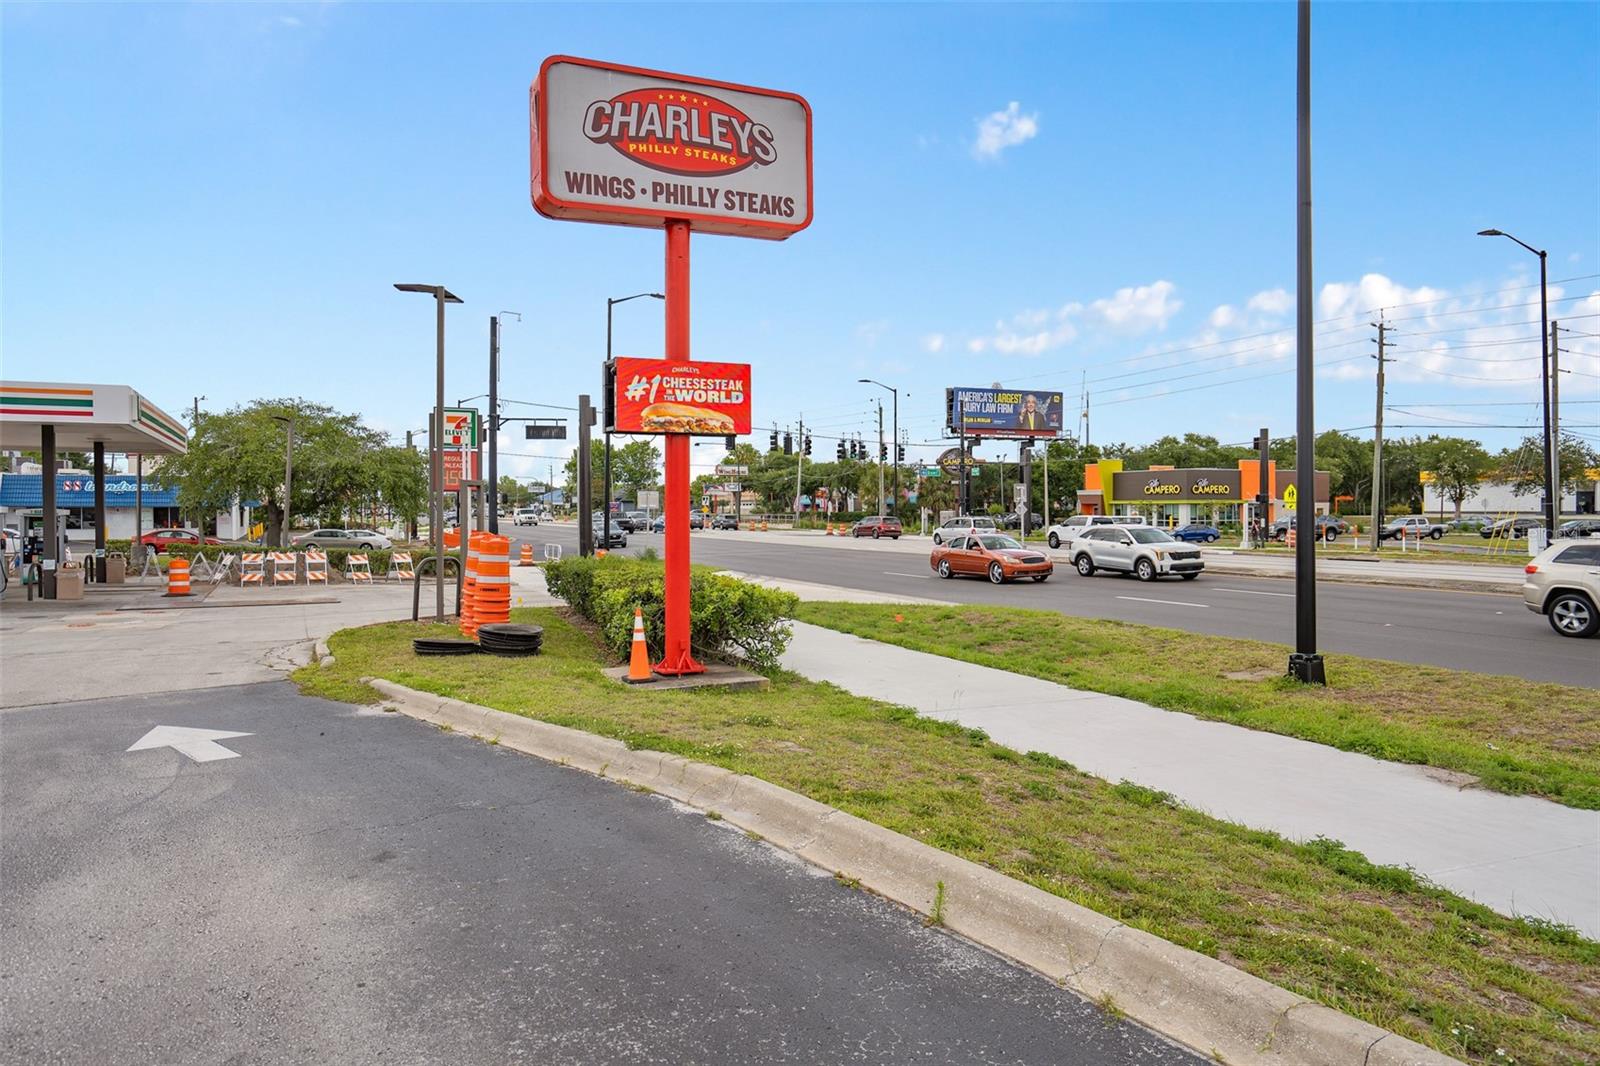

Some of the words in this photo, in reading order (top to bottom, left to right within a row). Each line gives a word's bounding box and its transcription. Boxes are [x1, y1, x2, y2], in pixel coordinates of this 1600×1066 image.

[584, 101, 776, 163] CHARLEYS
[629, 143, 679, 155] PHILLY
[684, 147, 737, 166] STEAKS
[565, 171, 635, 200] WINGS
[652, 181, 720, 209] PHILLY
[723, 190, 795, 217] STEAKS
[624, 374, 661, 404] #1
[663, 376, 743, 391] CHEESESTEAK
[675, 389, 744, 404] WORLD
[958, 391, 993, 403] AMERICA'S
[994, 393, 1022, 404] LARGEST
[958, 402, 981, 413] IJURY
[981, 403, 997, 413] LAW
[997, 403, 1014, 414] FIRM
[1144, 485, 1181, 494] CAMPERO
[1192, 485, 1230, 494] CAMPERO
